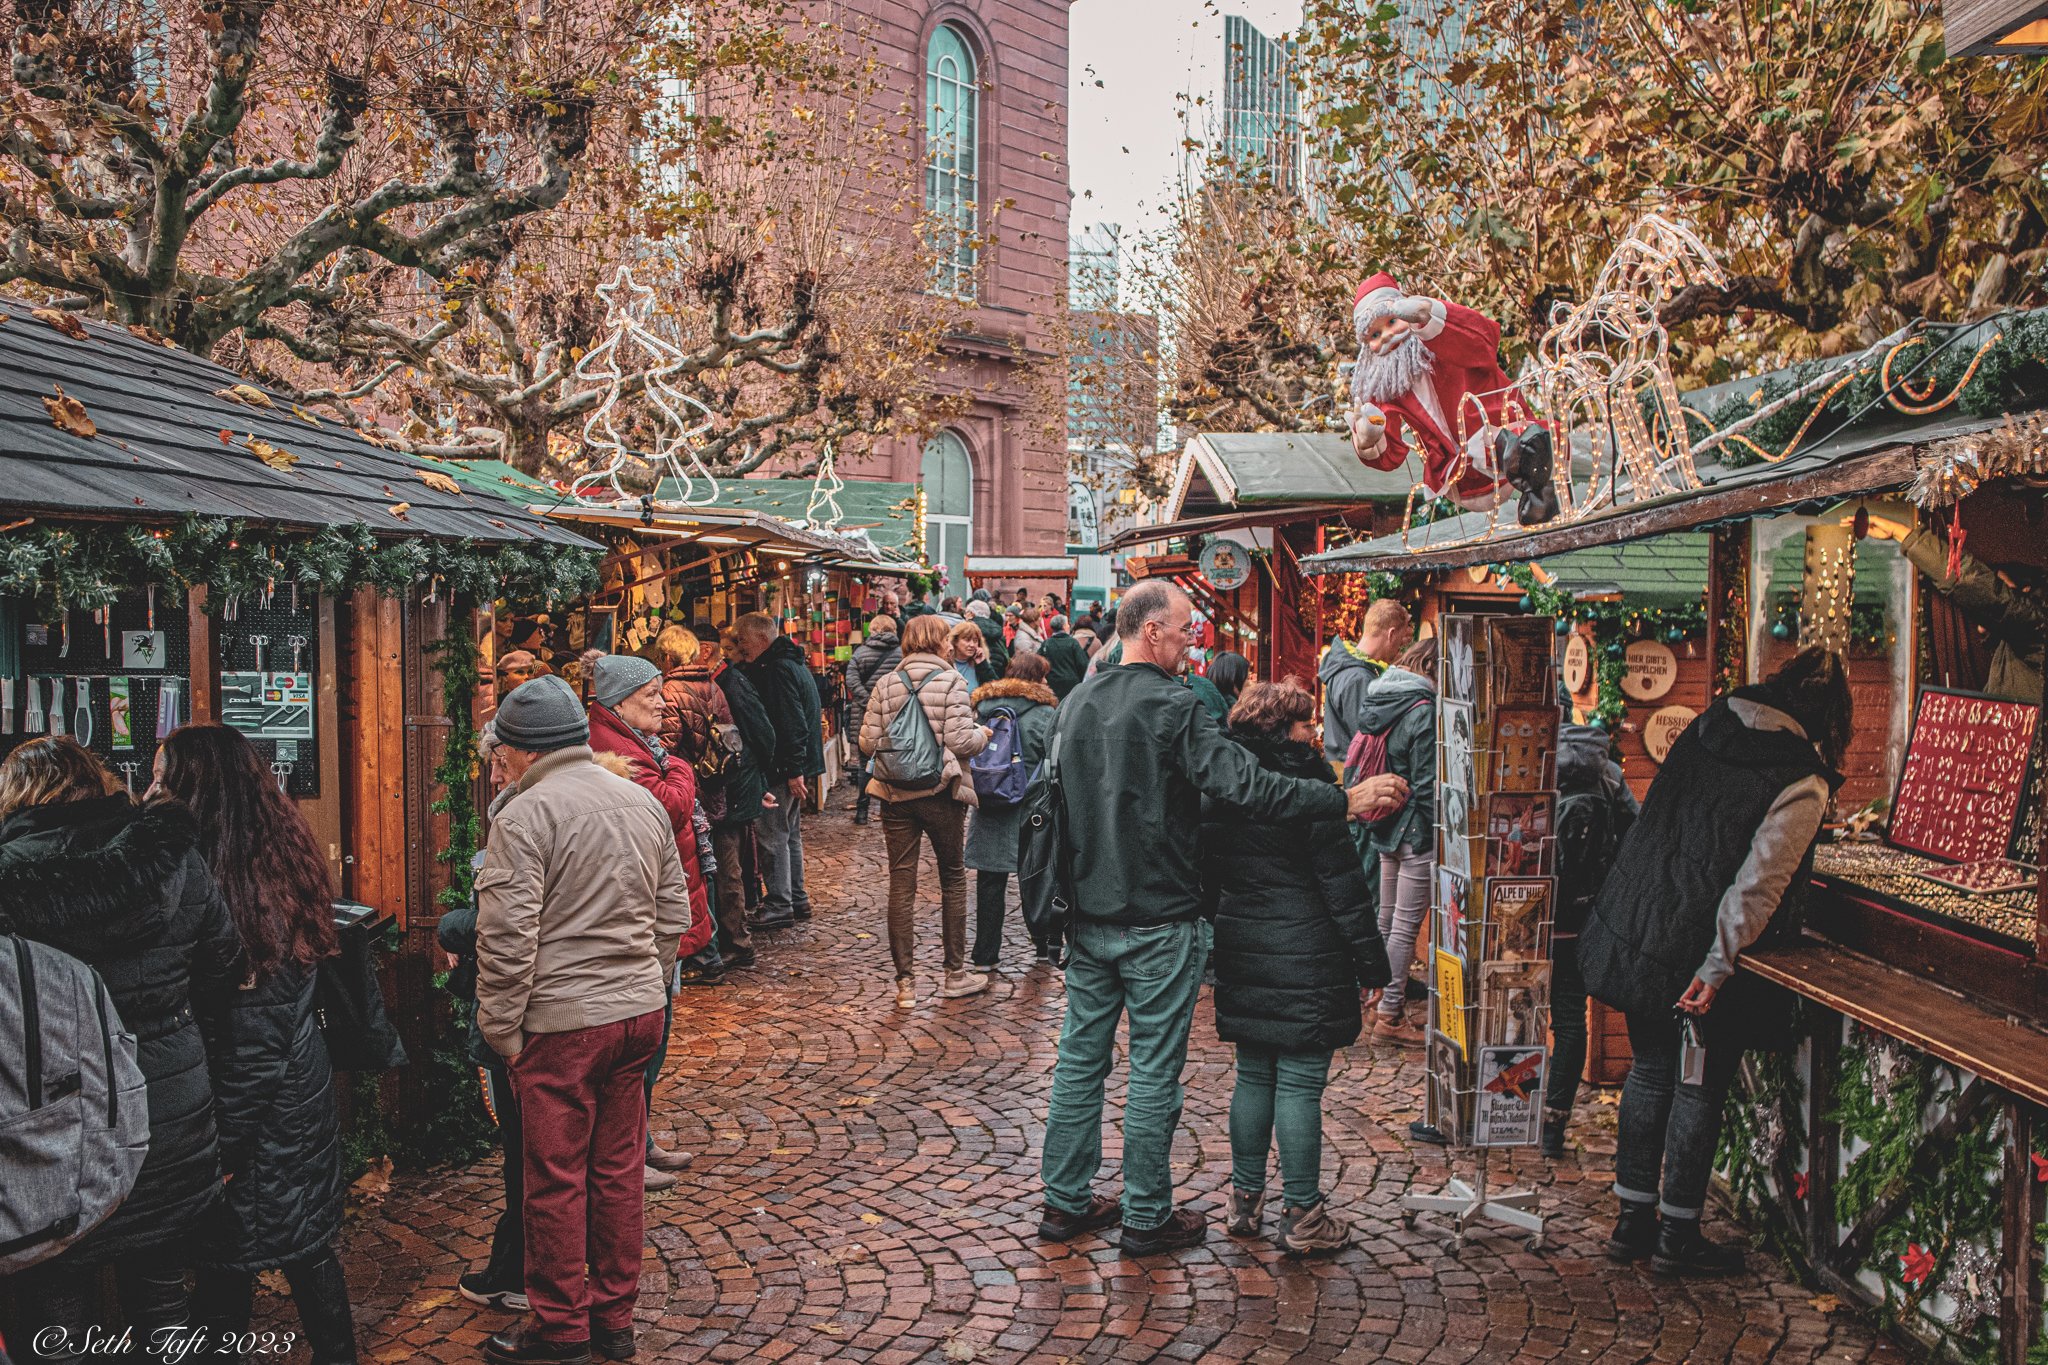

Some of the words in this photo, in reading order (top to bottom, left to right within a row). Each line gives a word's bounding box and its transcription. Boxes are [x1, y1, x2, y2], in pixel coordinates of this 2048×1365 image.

[1628, 654, 1643, 663] HIER
[1645, 655, 1667, 665] GIBT'S
[1495, 886, 1517, 903] ALPE
